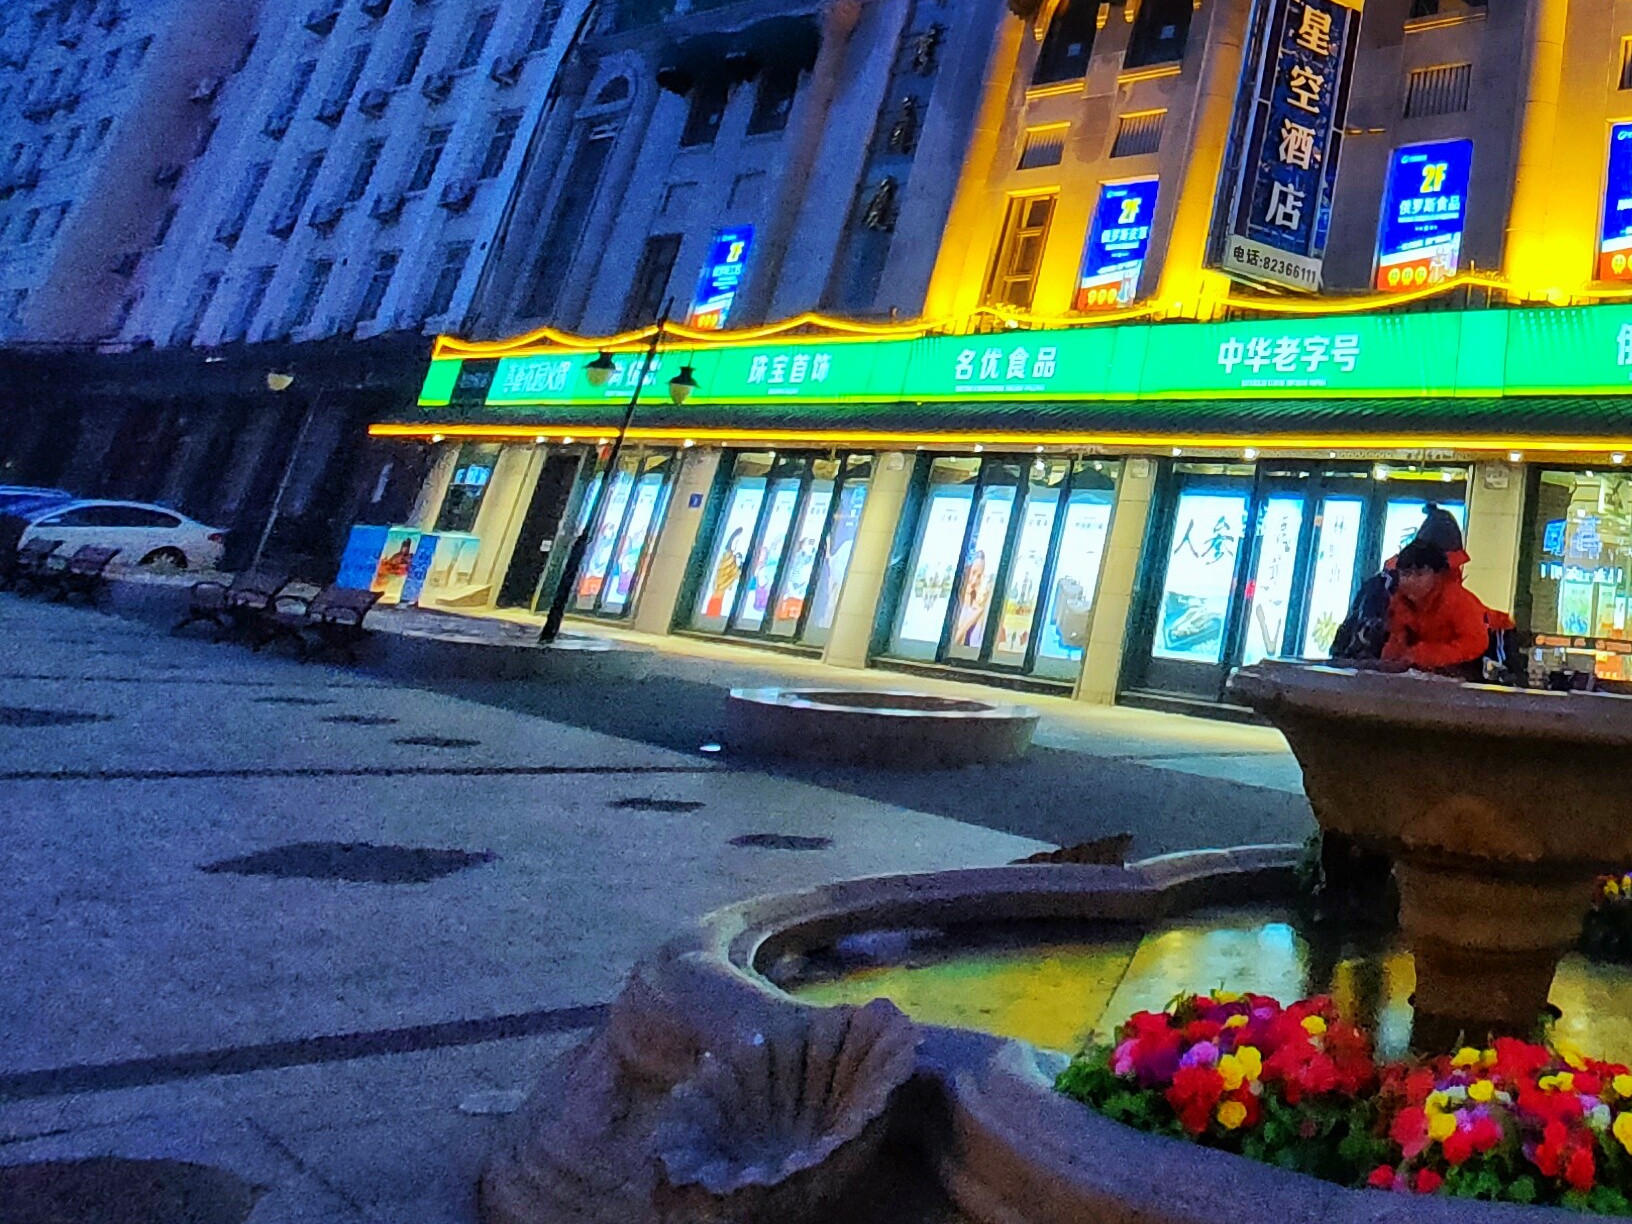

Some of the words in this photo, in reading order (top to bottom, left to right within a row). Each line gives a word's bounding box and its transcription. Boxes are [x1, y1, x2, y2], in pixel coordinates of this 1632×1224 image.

[1264, 4, 1333, 231] 星空酒店
[1420, 162, 1449, 194] 2F
[1232, 245, 1318, 284] 电话:82366111
[746, 352, 832, 384] 珠宝首饰
[954, 345, 1058, 381] 名优食品
[1217, 334, 1361, 374] 中华老字号
[1173, 515, 1235, 566] 人参
